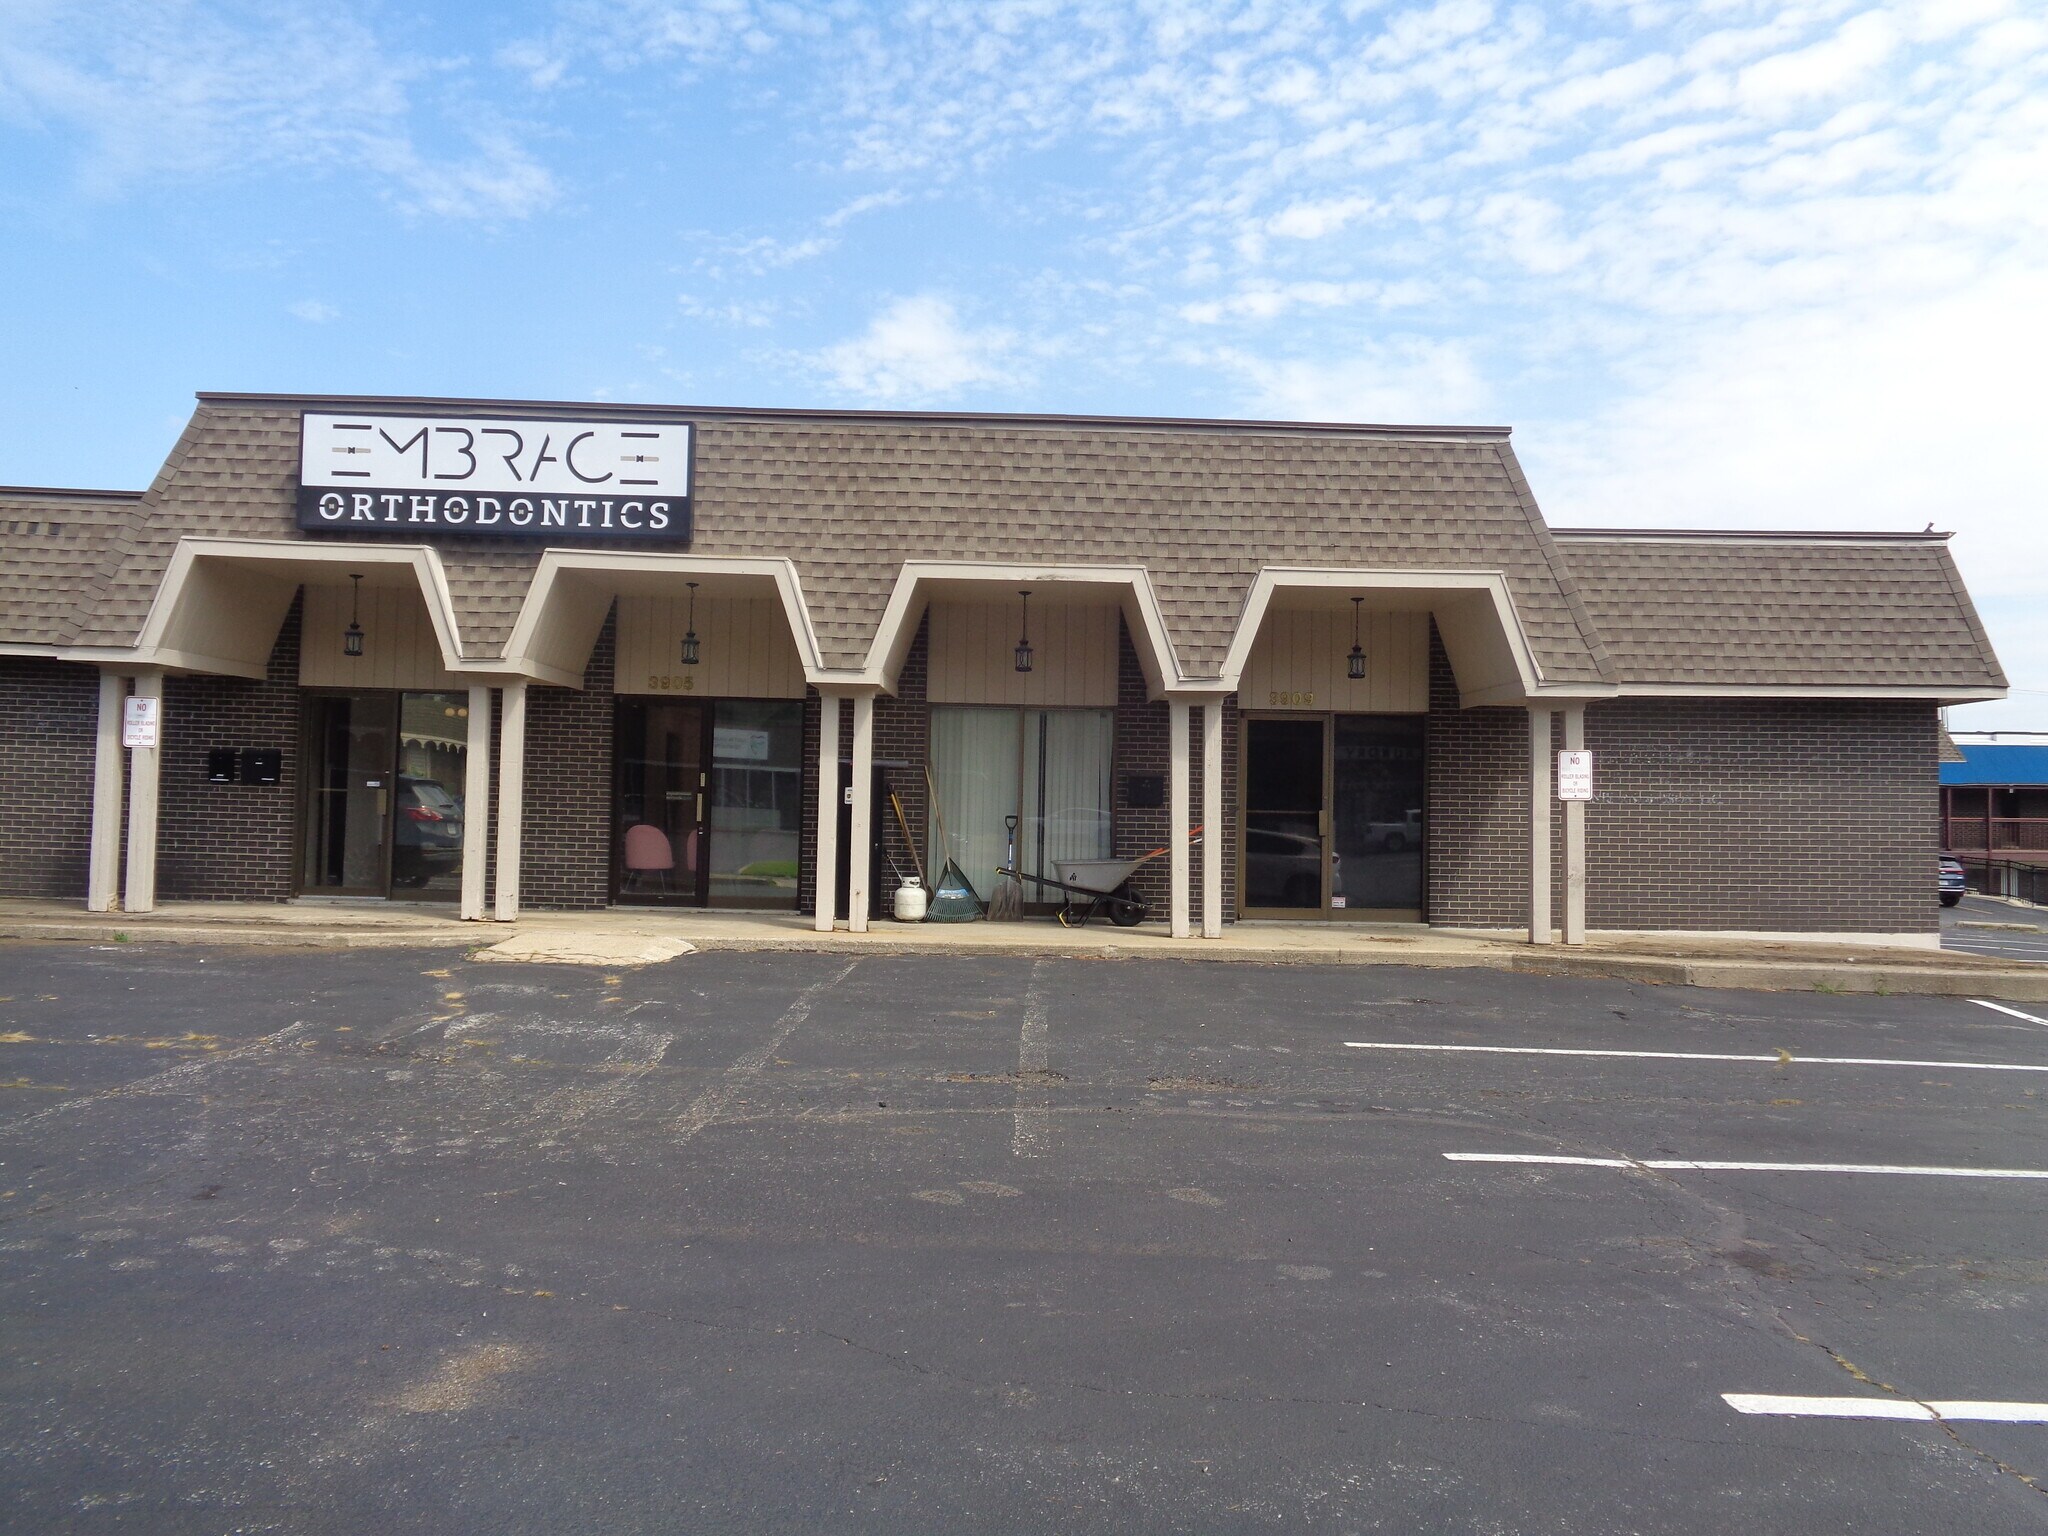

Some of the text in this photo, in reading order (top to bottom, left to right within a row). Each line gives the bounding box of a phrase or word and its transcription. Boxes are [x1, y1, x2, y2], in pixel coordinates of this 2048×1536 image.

[331, 424, 660, 485] EMBRACE
[319, 492, 670, 530] ORTHODONTICS
[648, 675, 694, 690] 3905
[1269, 691, 1314, 706] 3909
[136, 703, 147, 712] NO
[1570, 756, 1580, 765] NO
